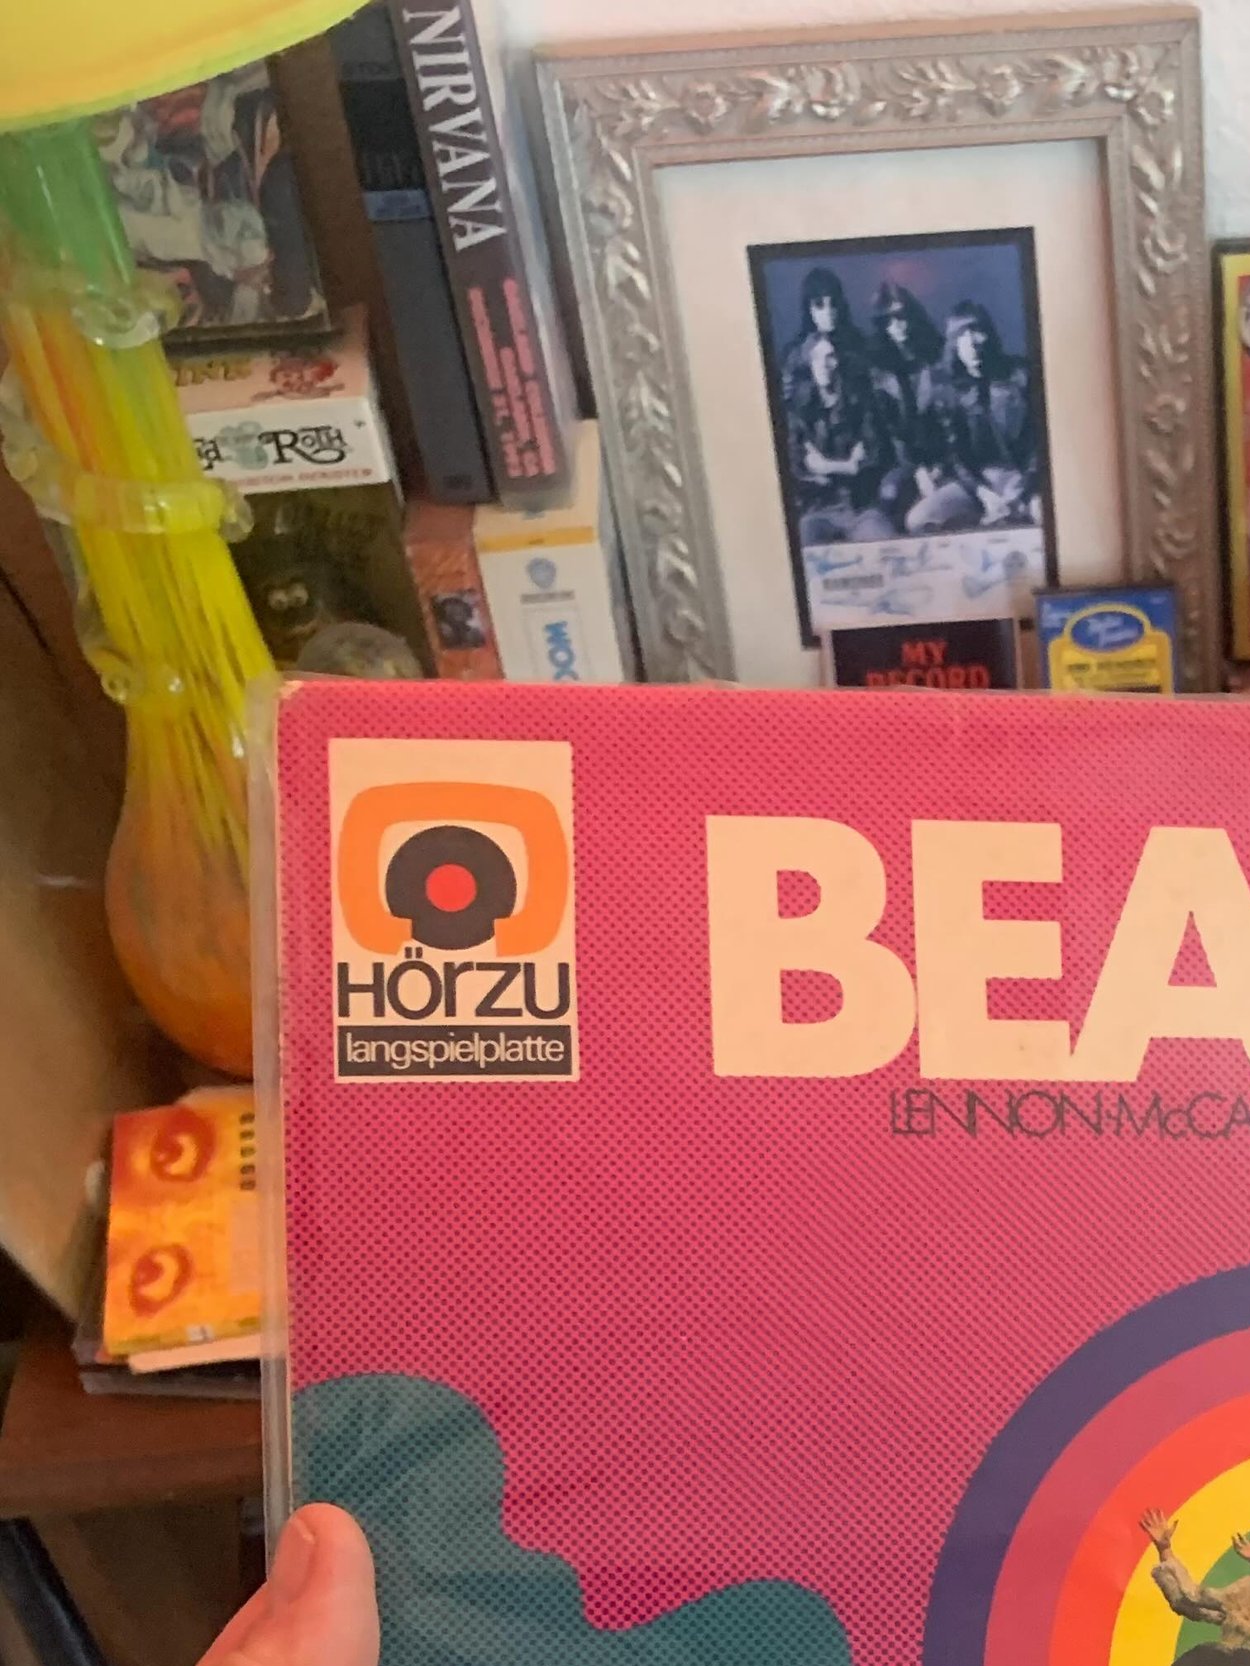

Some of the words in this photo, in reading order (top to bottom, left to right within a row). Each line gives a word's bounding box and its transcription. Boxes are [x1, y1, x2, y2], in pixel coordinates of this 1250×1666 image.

[402, 6, 508, 252] NIRVANA
[902, 640, 948, 665] MY
[346, 1032, 565, 1069] langspielplatte
